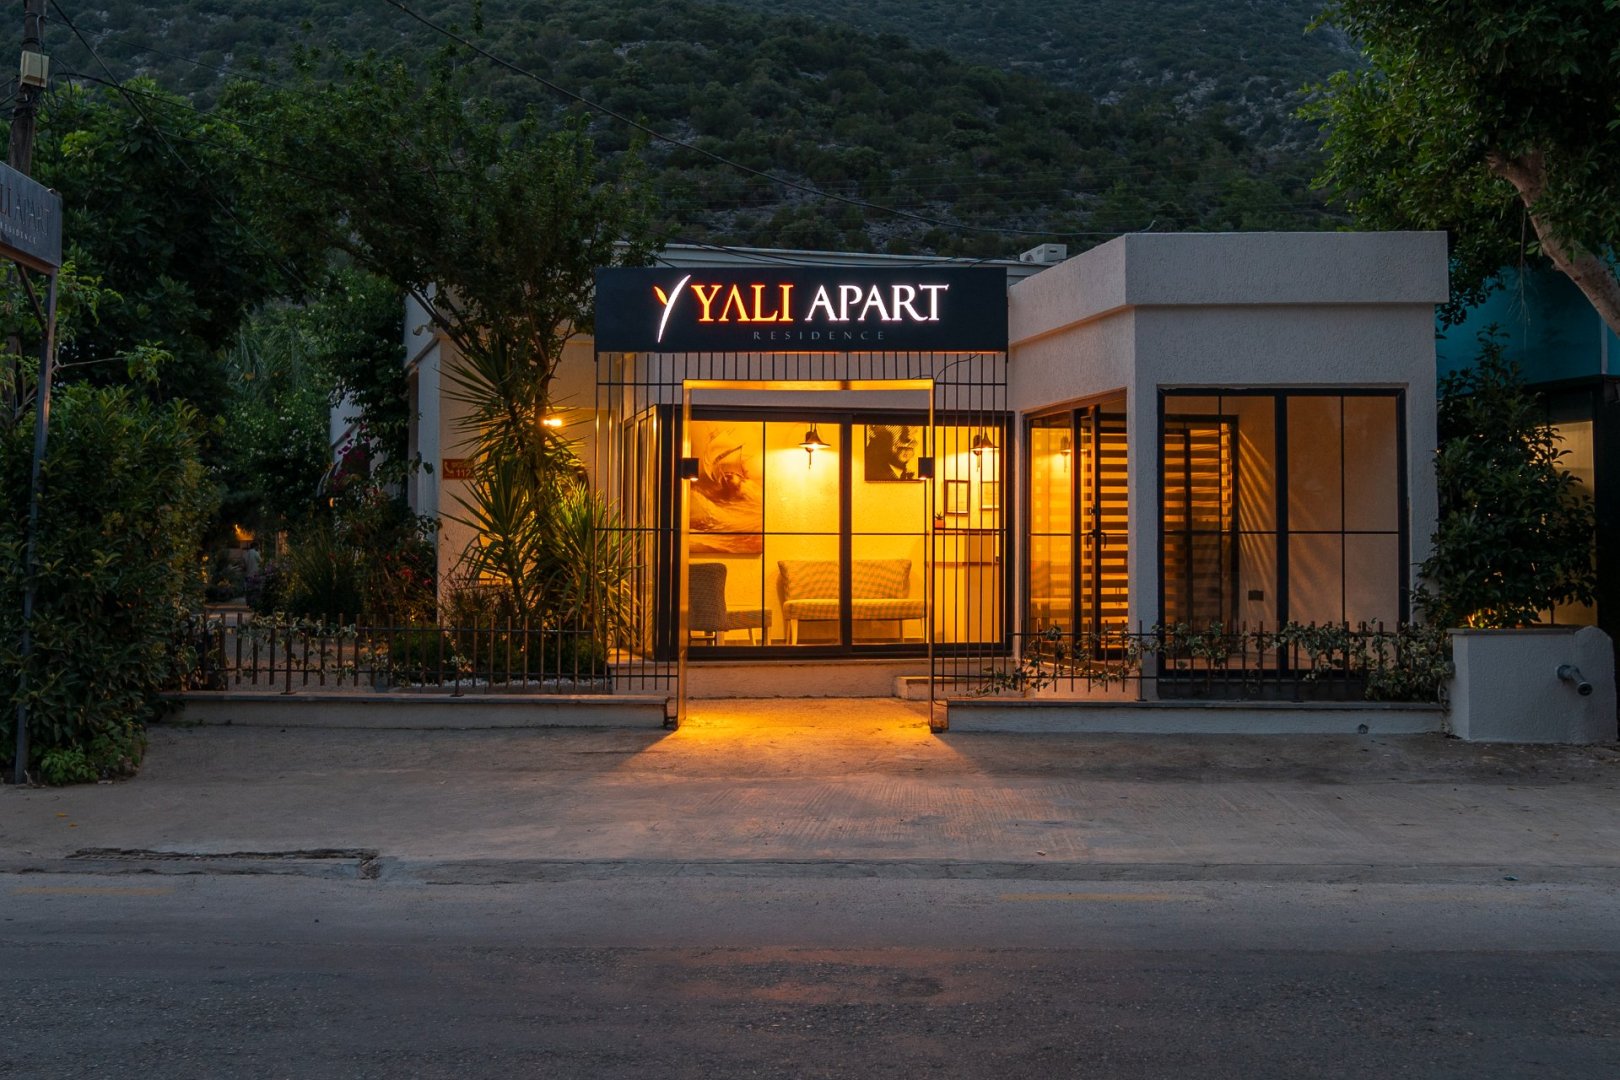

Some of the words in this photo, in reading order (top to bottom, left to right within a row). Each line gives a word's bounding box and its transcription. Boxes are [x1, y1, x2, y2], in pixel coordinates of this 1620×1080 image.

[690, 284, 794, 322] YALI
[804, 283, 950, 322] APART
[753, 331, 885, 340] RESIDENCE
